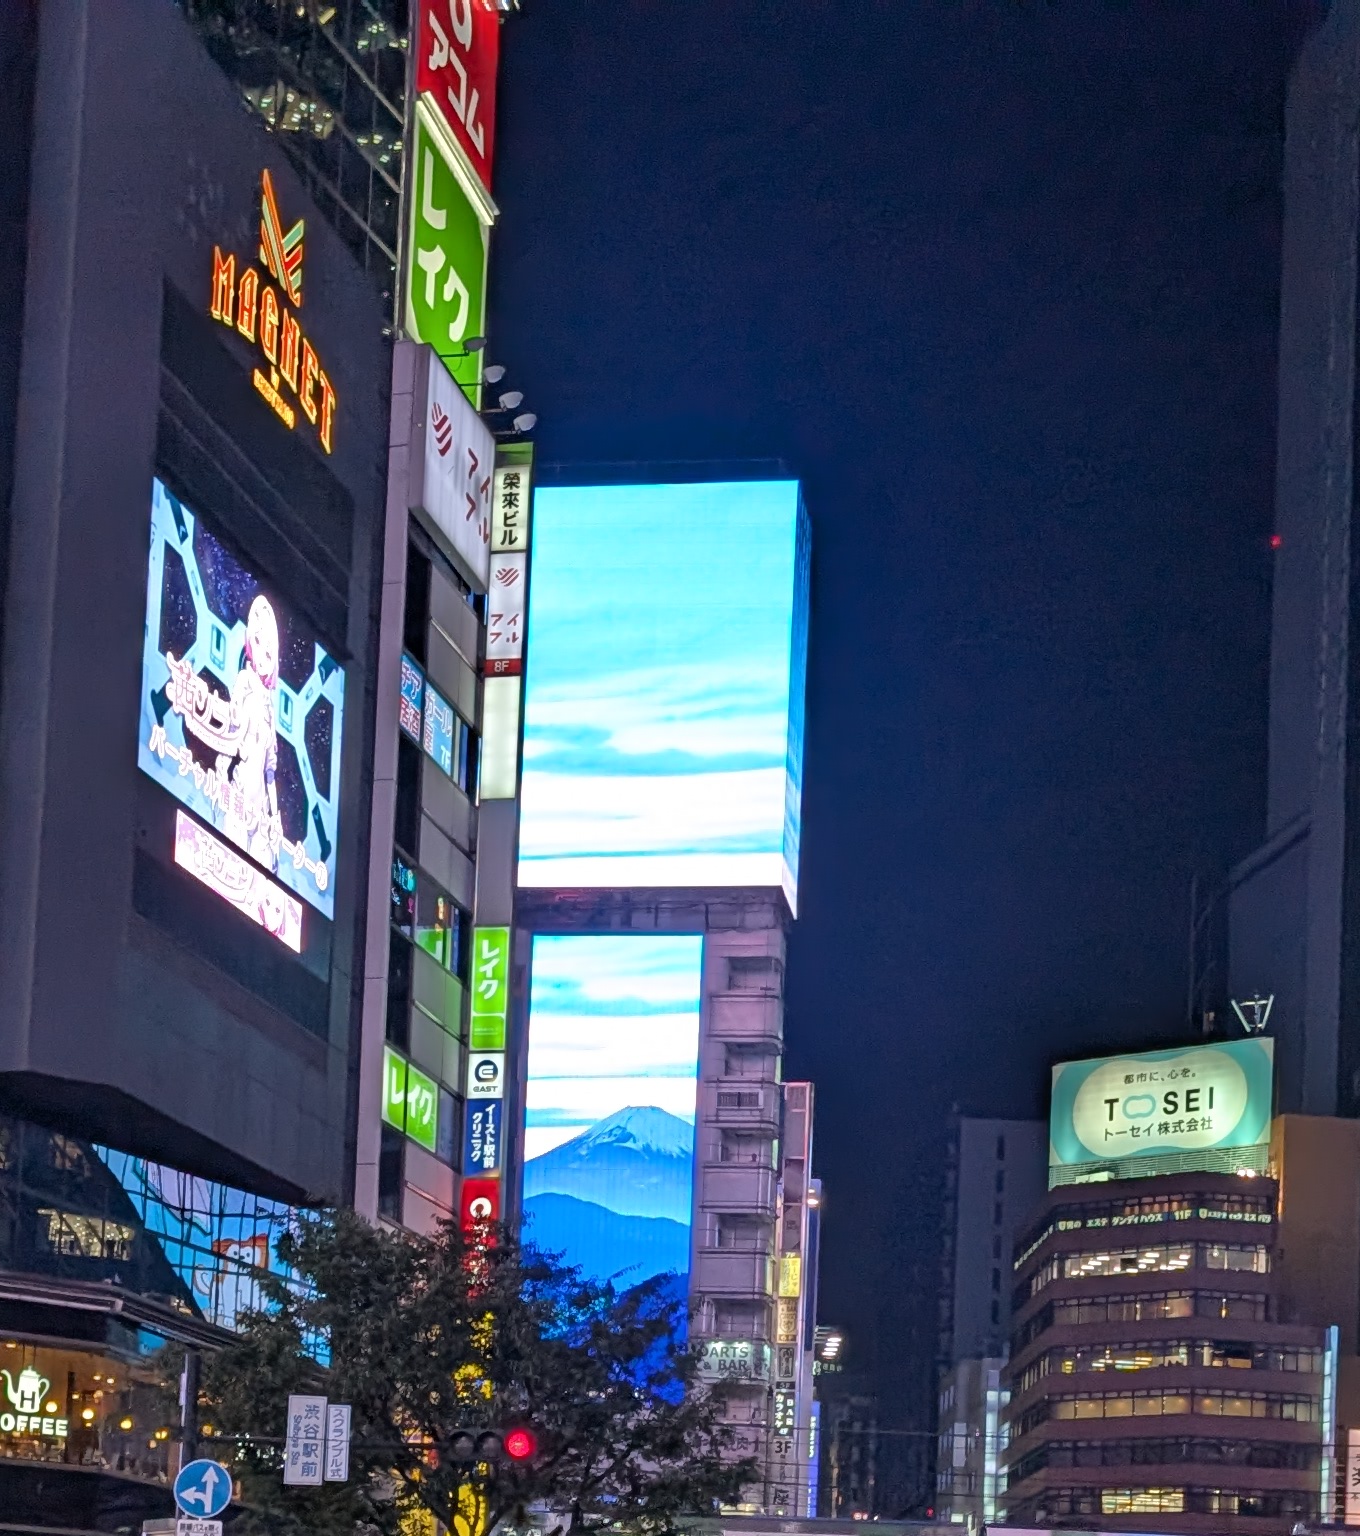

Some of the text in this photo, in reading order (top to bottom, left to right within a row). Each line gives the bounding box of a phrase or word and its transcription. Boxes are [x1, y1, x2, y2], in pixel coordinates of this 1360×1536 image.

[417, 145, 470, 342] レイク
[210, 245, 337, 455] MAGNET
[494, 661, 510, 674] 8F
[477, 939, 500, 1000] レイク
[1123, 1067, 1197, 1085] 都市に、心を。
[391, 1066, 433, 1126] レイク
[1104, 1116, 1214, 1142] トーセイ株式会社
[1173, 1209, 1193, 1221] 11F
[700, 1346, 749, 1358] DARTS
[718, 1359, 748, 1372] BAR
[774, 1393, 785, 1429] カラオケ
[785, 1398, 794, 1426] BAR
[300, 1403, 321, 1478] 渋谷駅前
[329, 1407, 346, 1479] スクランブル式
[774, 1440, 793, 1454] 3F
